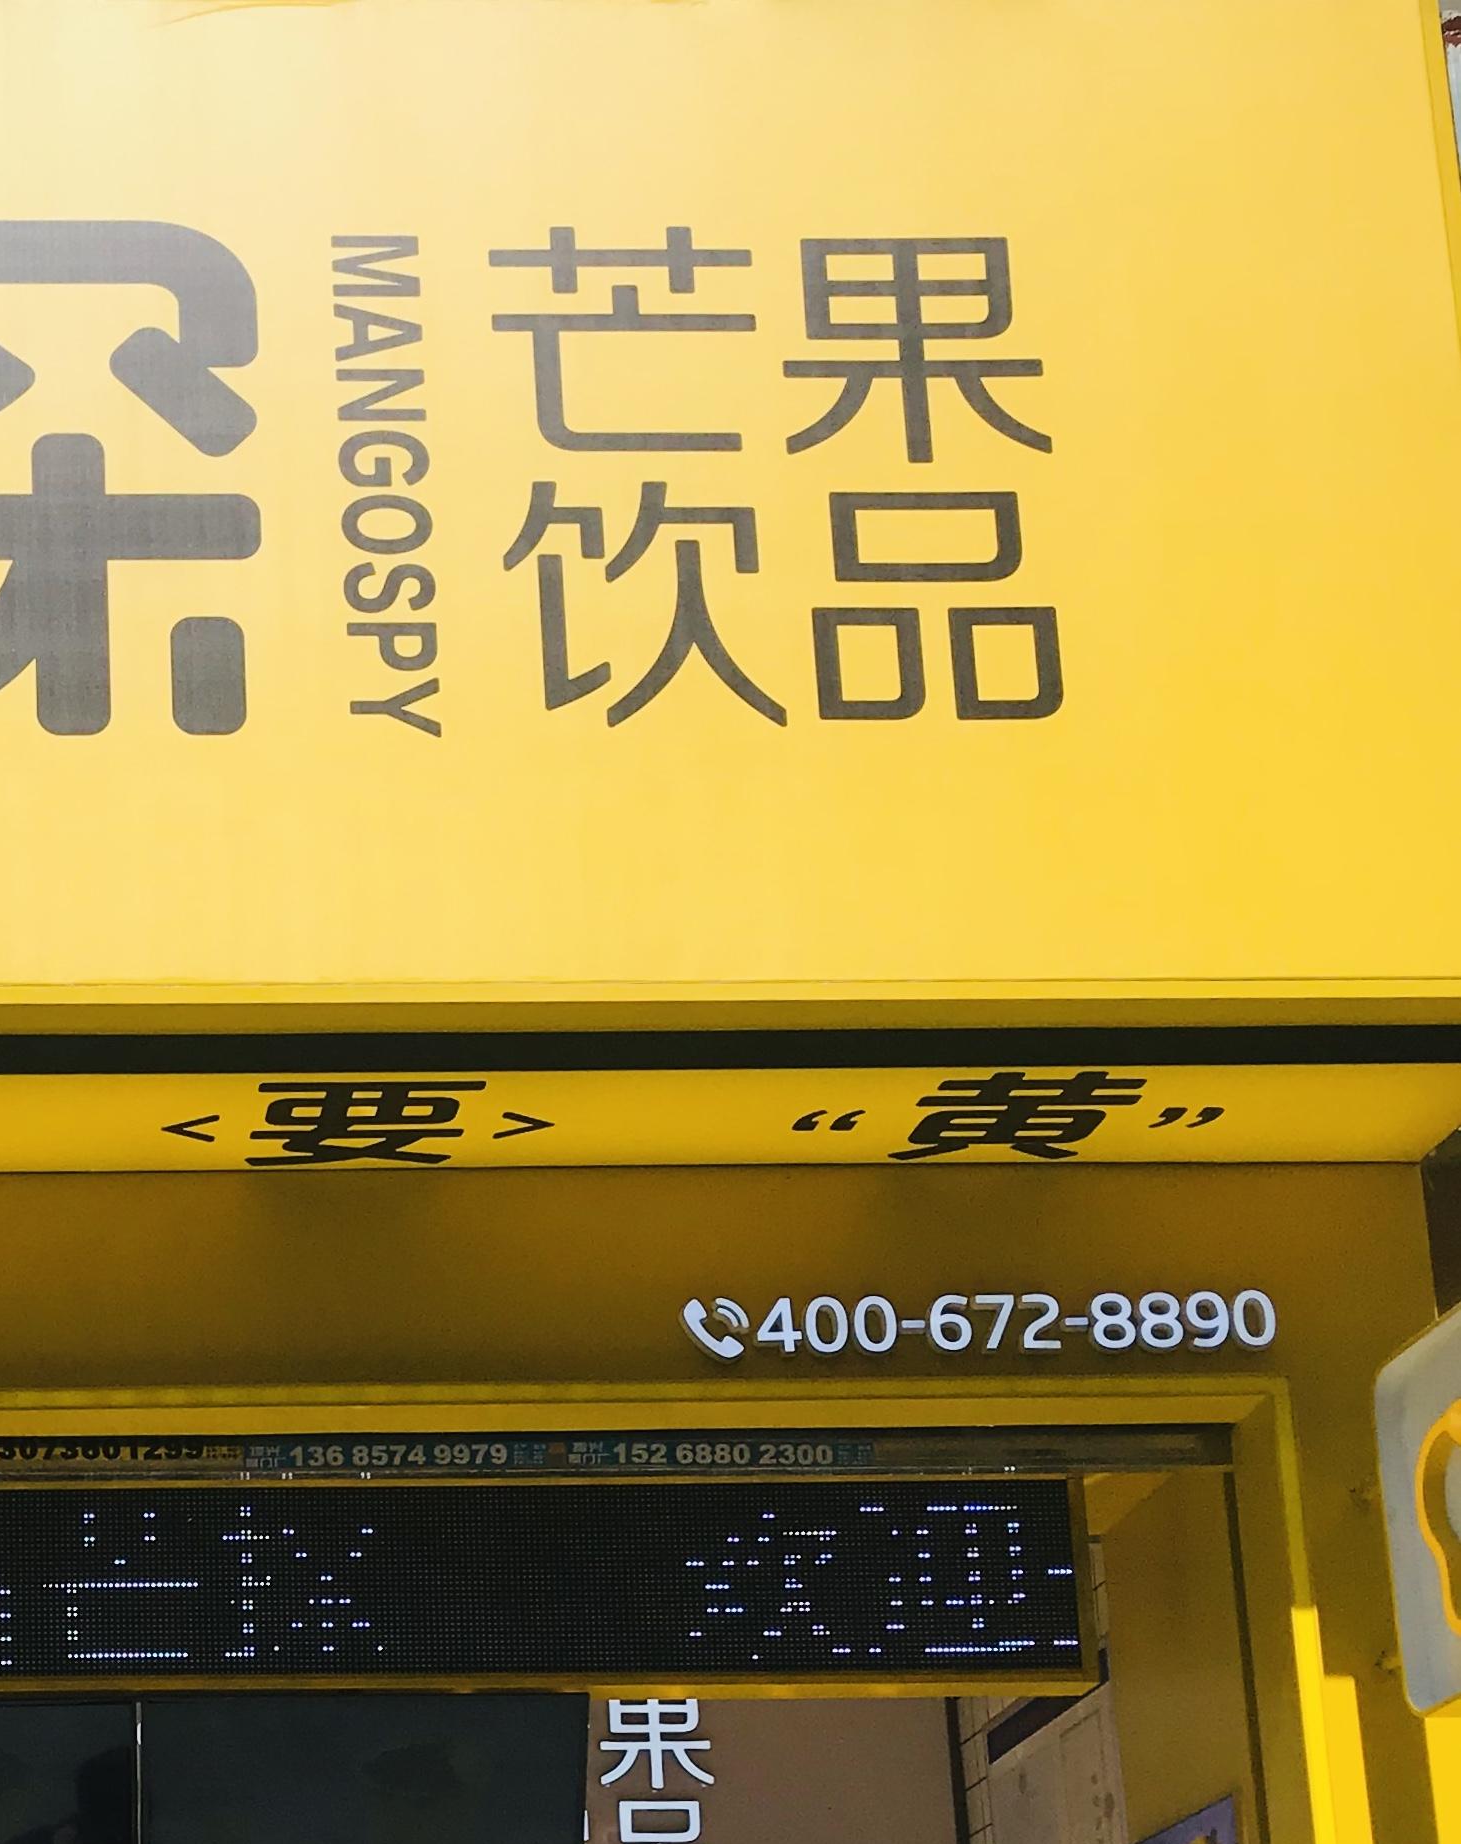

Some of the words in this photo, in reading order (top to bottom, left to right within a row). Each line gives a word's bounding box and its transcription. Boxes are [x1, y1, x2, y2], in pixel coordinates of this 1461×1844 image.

[488, 226, 1053, 463] 芒果
[330, 234, 442, 738] MANGOSPY
[503, 480, 1065, 728] 饮品
[757, 1289, 1277, 1353] 400-672-8890
[290, 1444, 344, 1466] 136
[352, 1444, 426, 1466] 8574
[433, 1443, 508, 1465] 9979
[613, 1443, 667, 1465] 152
[676, 1443, 750, 1465] 6880
[758, 1443, 833, 1465] 2300
